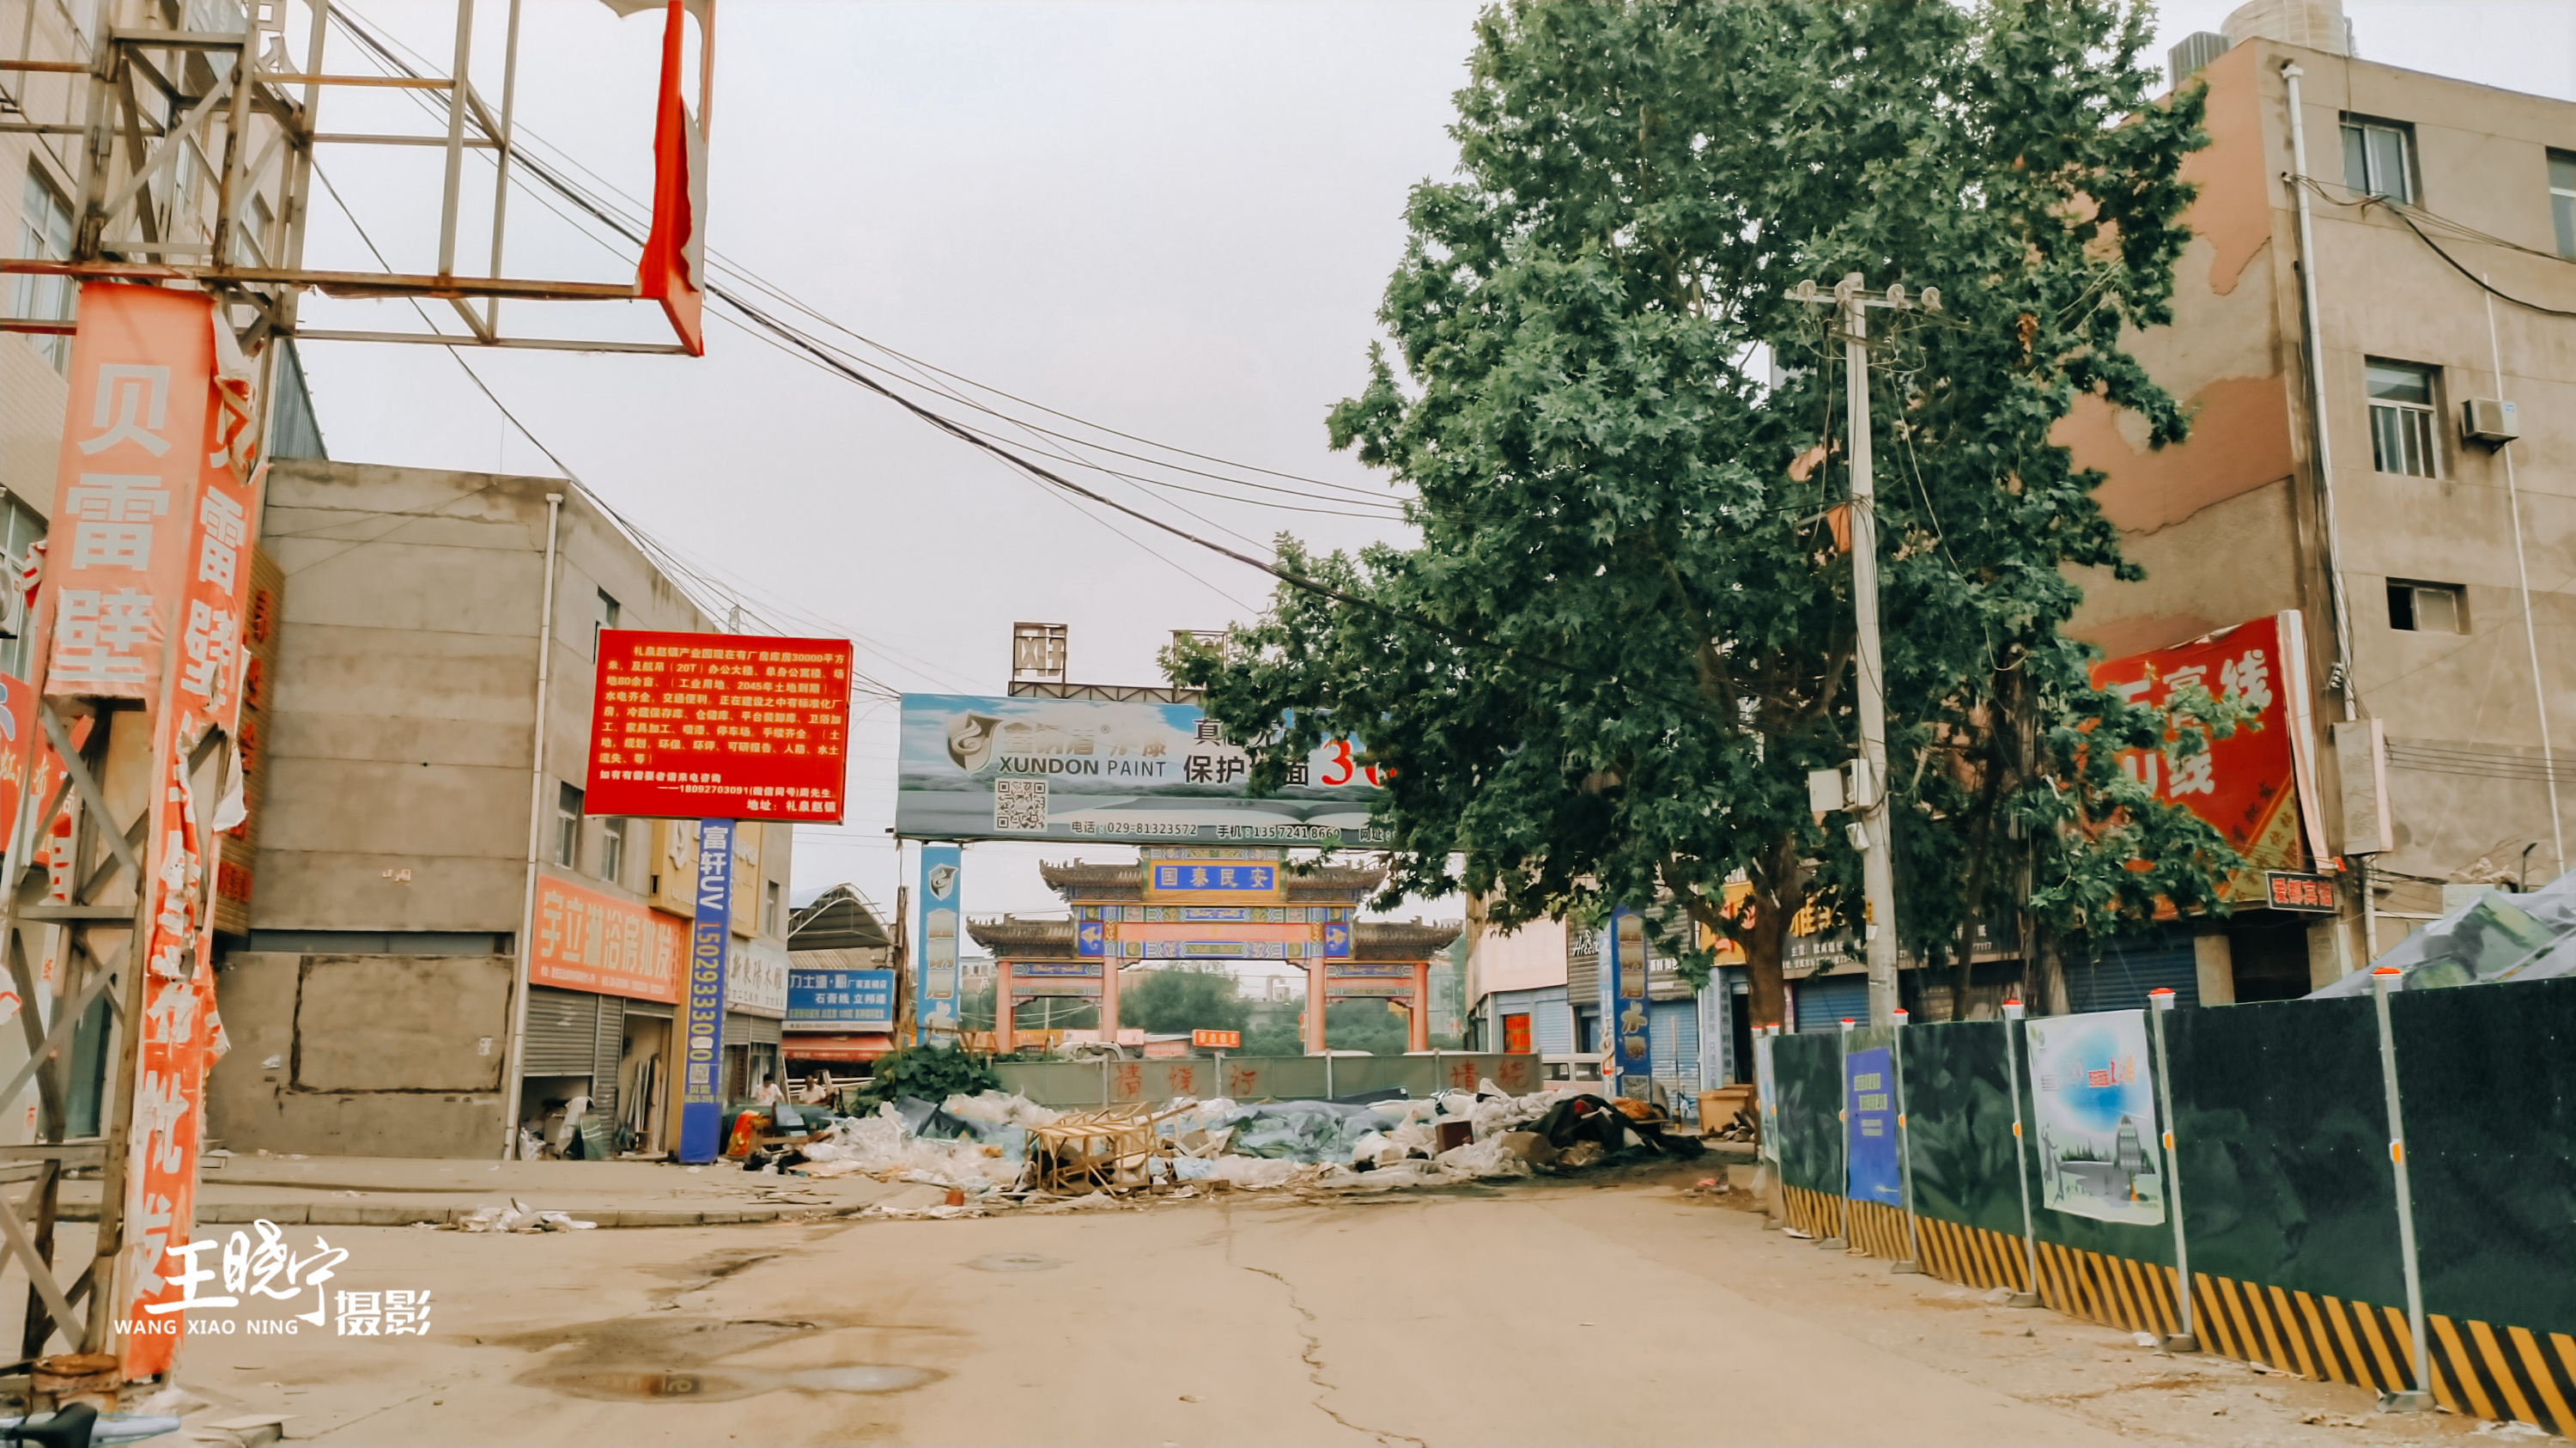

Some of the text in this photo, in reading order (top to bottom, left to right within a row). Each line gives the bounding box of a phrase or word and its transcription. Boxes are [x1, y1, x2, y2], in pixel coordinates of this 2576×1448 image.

[49, 363, 172, 684] 贝雷壁
[998, 756, 1166, 777] XUNDON PAINT
[1183, 755, 1309, 787] 保护面
[699, 825, 729, 910] 富轩UV
[1161, 866, 1270, 889] 国泰民安
[689, 922, 722, 1062] 1502933300
[1115, 1064, 1255, 1098] 请绕行
